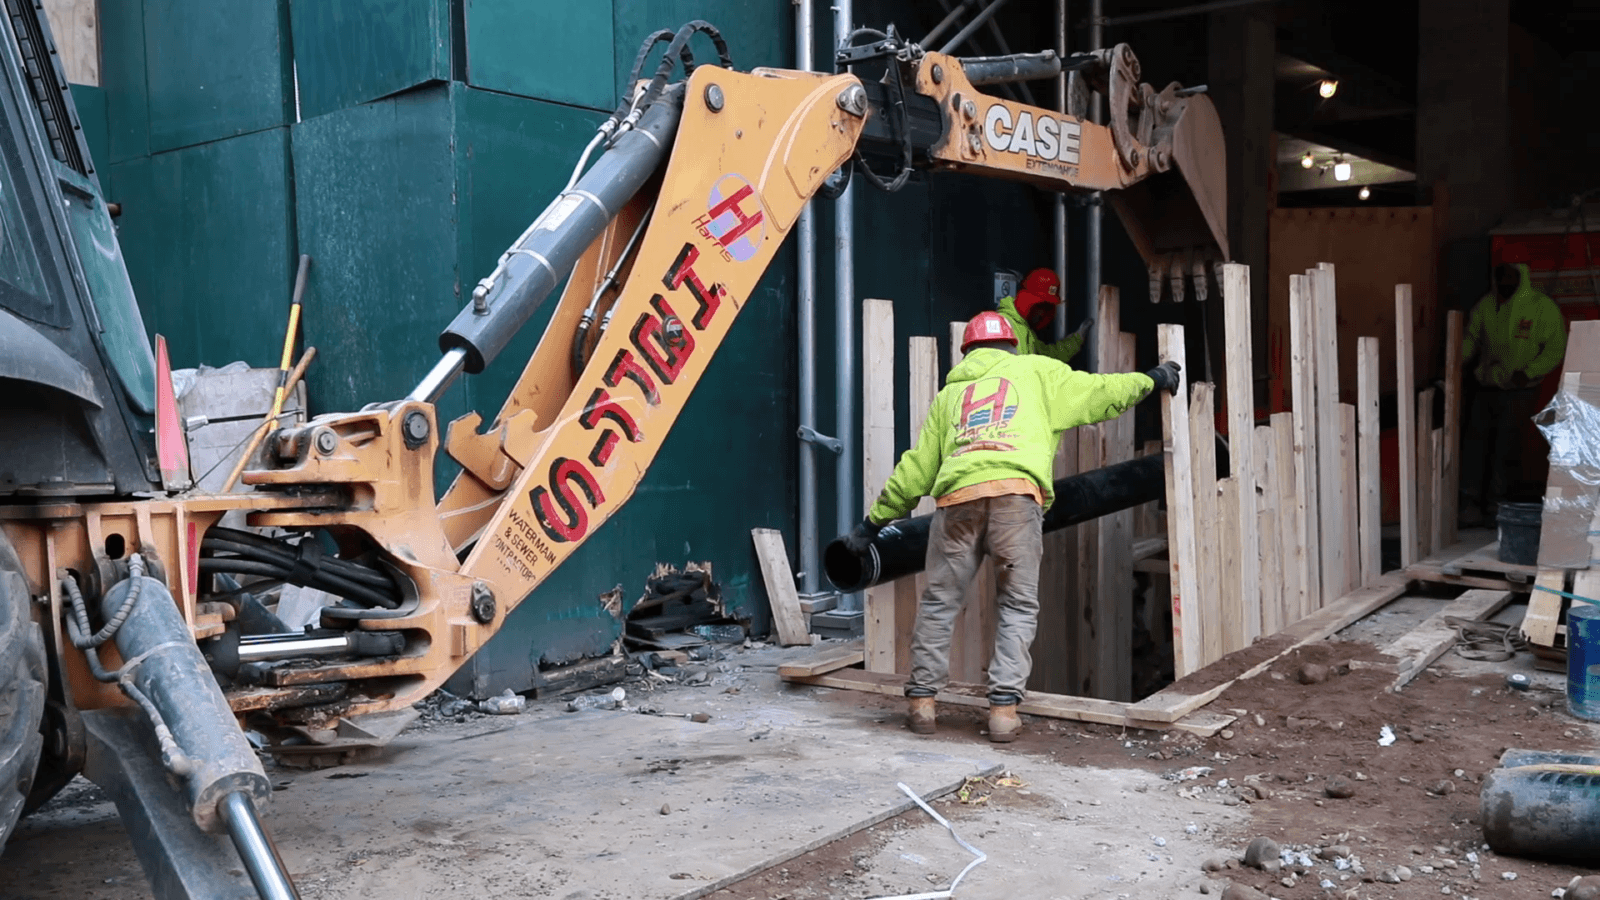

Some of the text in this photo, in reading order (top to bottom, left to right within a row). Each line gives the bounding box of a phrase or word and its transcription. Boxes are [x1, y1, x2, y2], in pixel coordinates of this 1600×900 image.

[984, 103, 1081, 165] CASE
[690, 213, 734, 264] Harris
[511, 534, 538, 567] SEWER
